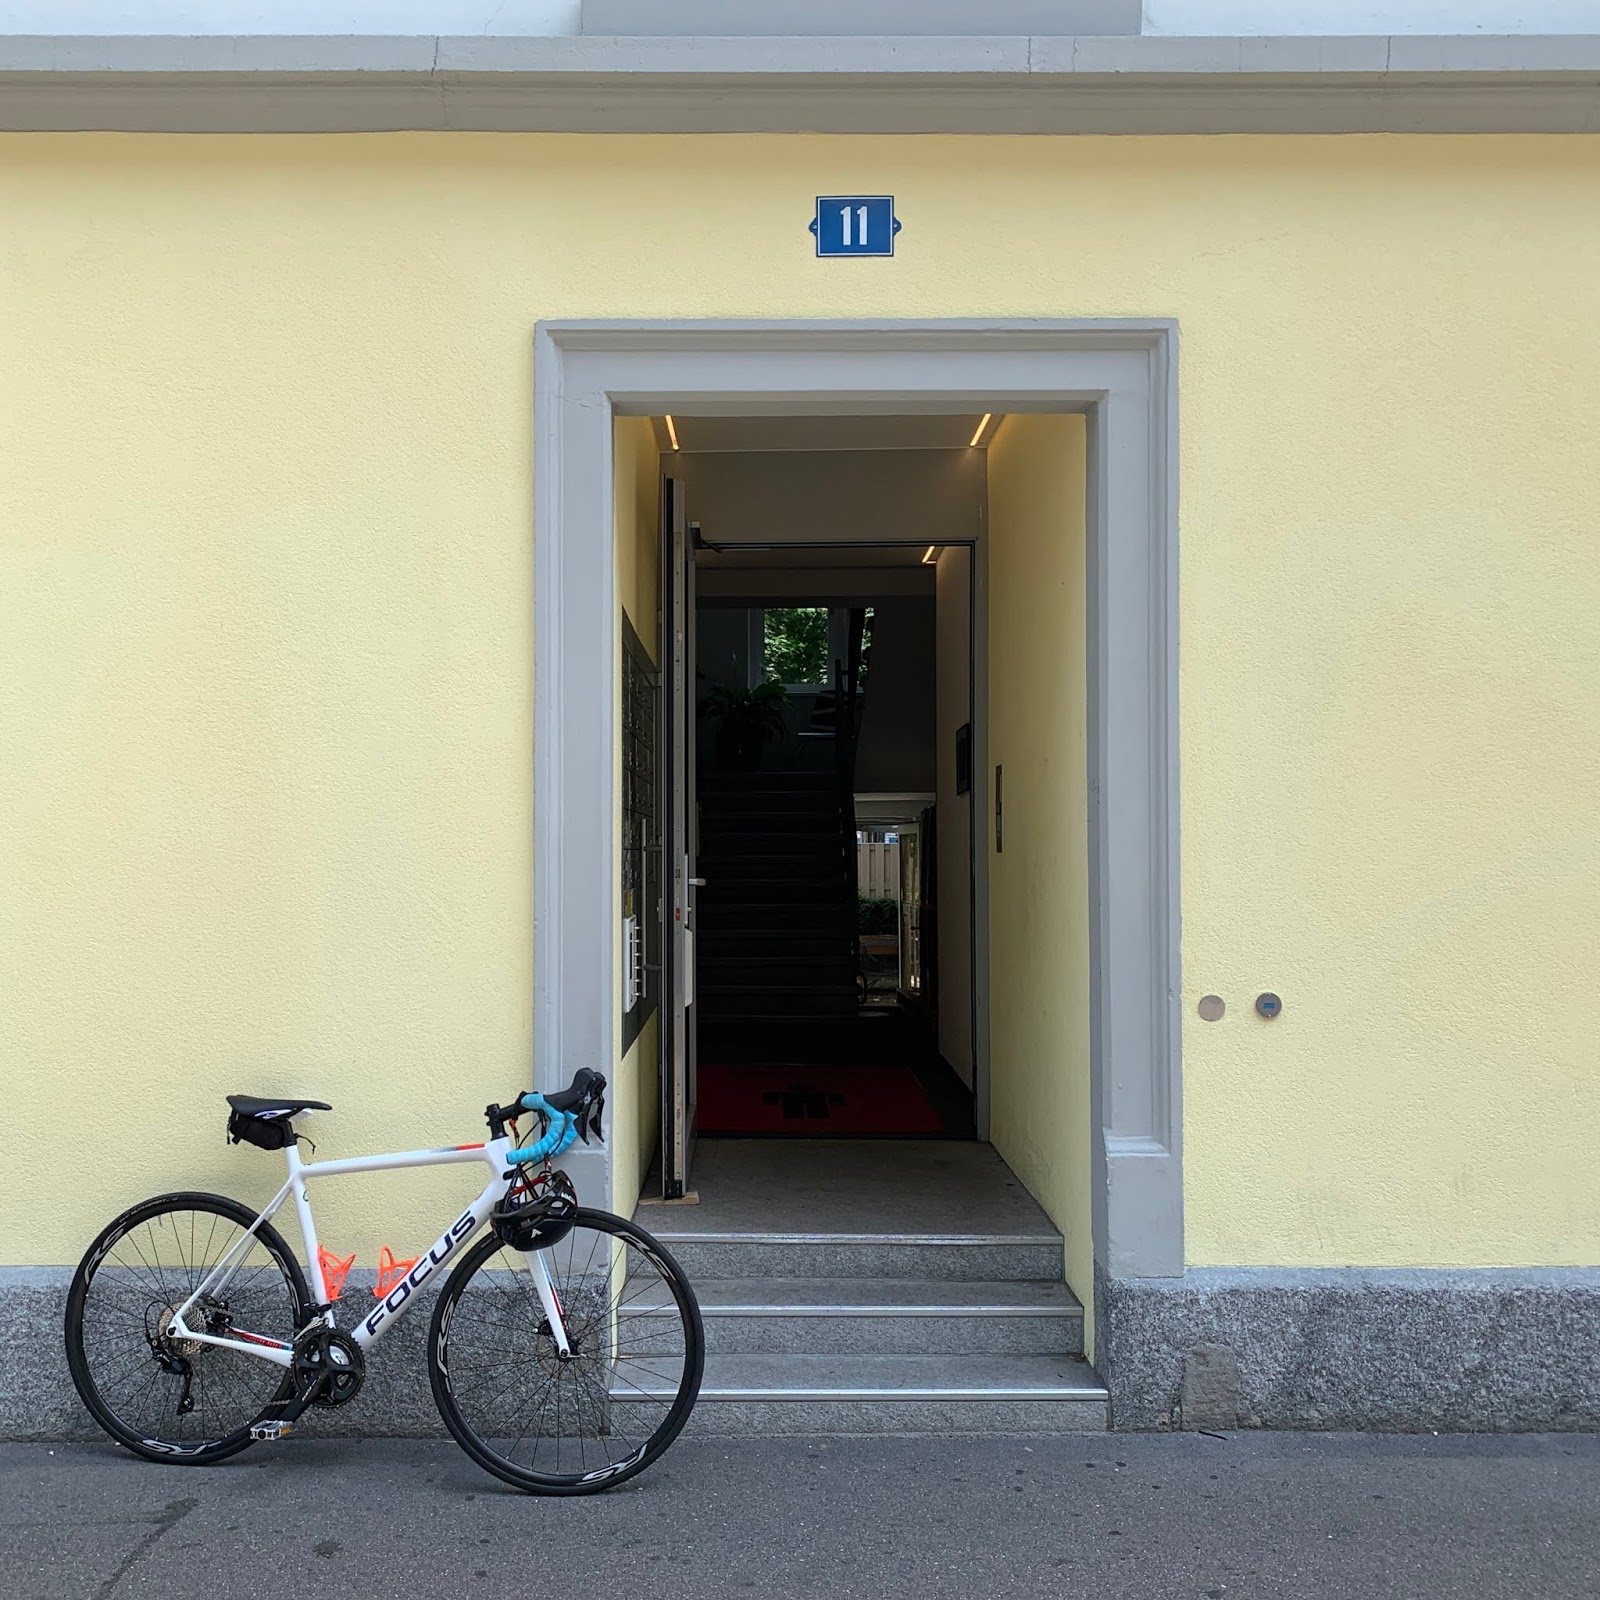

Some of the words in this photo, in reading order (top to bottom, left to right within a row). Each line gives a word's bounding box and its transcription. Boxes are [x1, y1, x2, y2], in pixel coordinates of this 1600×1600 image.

[840, 206, 867, 245] 11
[84, 1221, 127, 1285] RS
[366, 1210, 475, 1336] FOCUS
[611, 1231, 677, 1281] RS
[575, 1443, 648, 1486] RS
